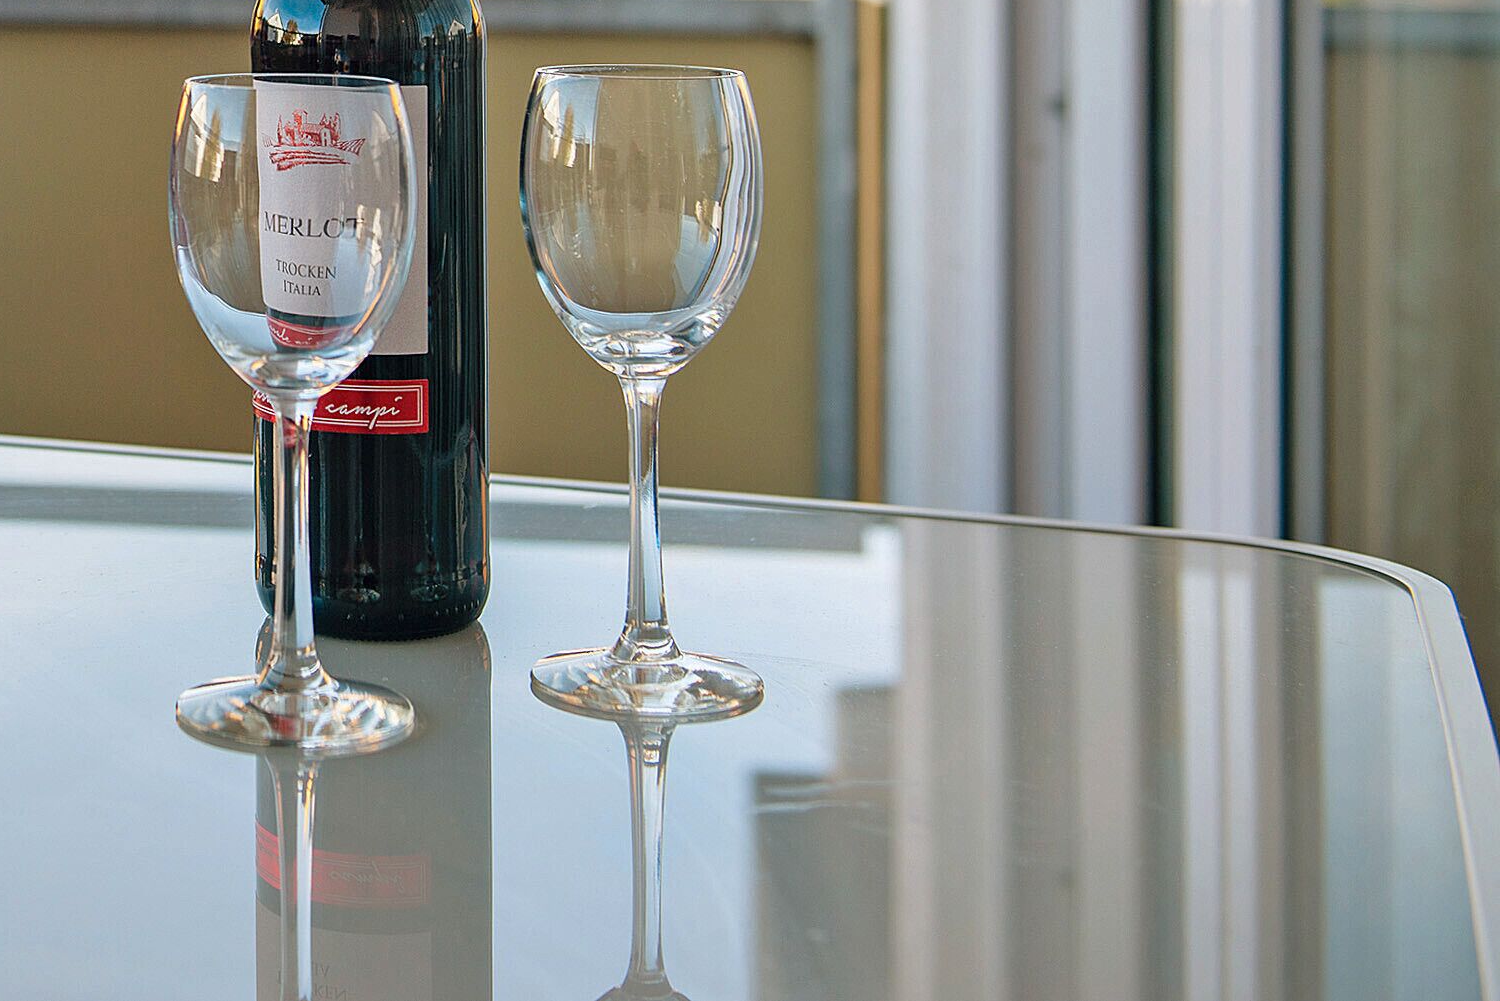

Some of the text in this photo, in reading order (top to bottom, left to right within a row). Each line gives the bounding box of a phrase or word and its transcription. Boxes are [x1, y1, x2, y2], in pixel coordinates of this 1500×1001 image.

[264, 211, 364, 239] MERLOT
[275, 259, 337, 279] TROCKEN
[283, 280, 321, 296] ITALIA
[325, 396, 403, 430] campi
